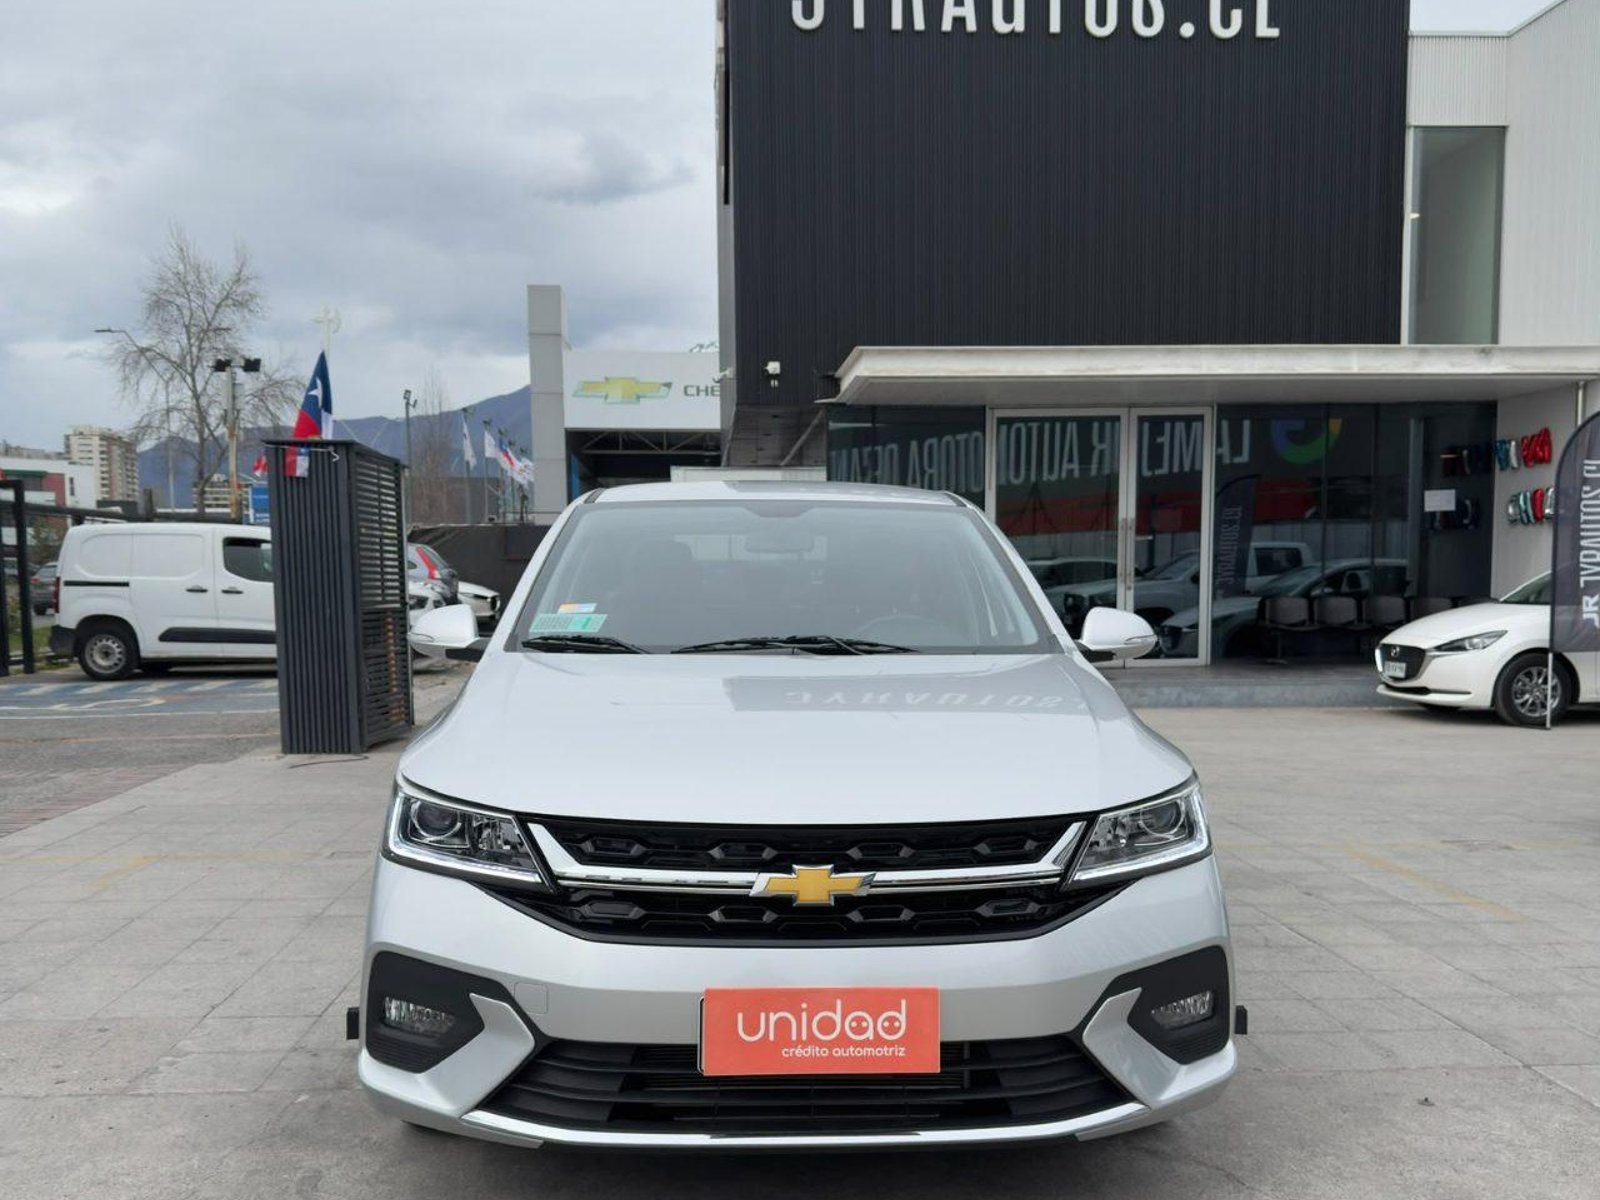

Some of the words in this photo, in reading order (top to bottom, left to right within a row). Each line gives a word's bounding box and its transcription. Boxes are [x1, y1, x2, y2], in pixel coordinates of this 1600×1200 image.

[737, 999, 907, 1042] unidad
[782, 1045, 829, 1058] crédito
[832, 1045, 906, 1057] automotriz
